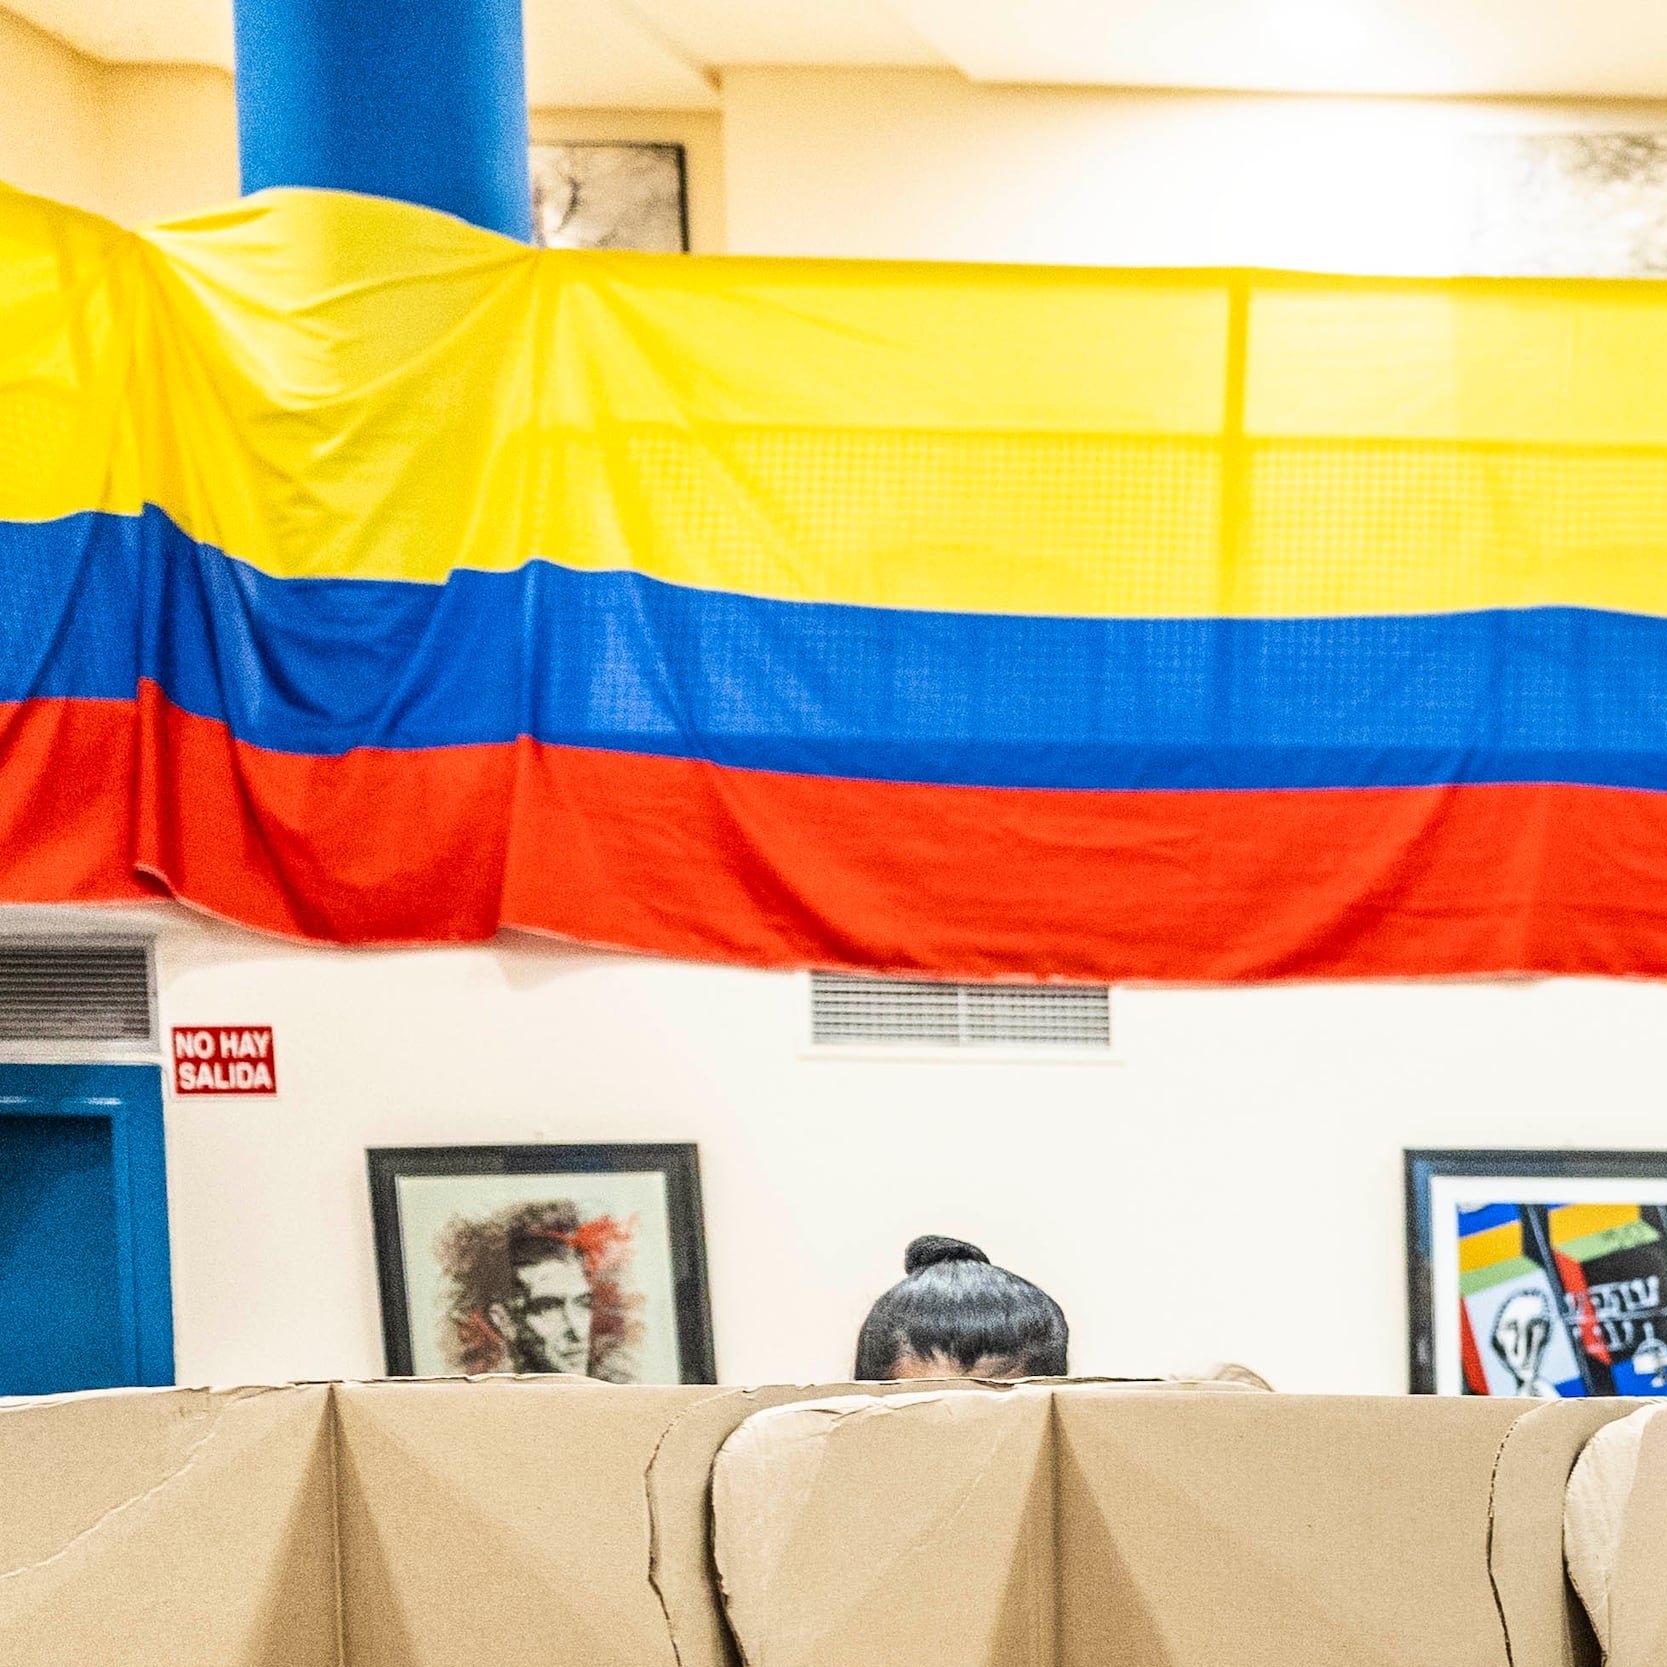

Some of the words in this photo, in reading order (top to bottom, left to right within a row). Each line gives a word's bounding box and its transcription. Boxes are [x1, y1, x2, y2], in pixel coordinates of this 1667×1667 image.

[176, 1030, 215, 1059] NO
[220, 1030, 271, 1059] HAY
[179, 1062, 272, 1090] SALIDA
